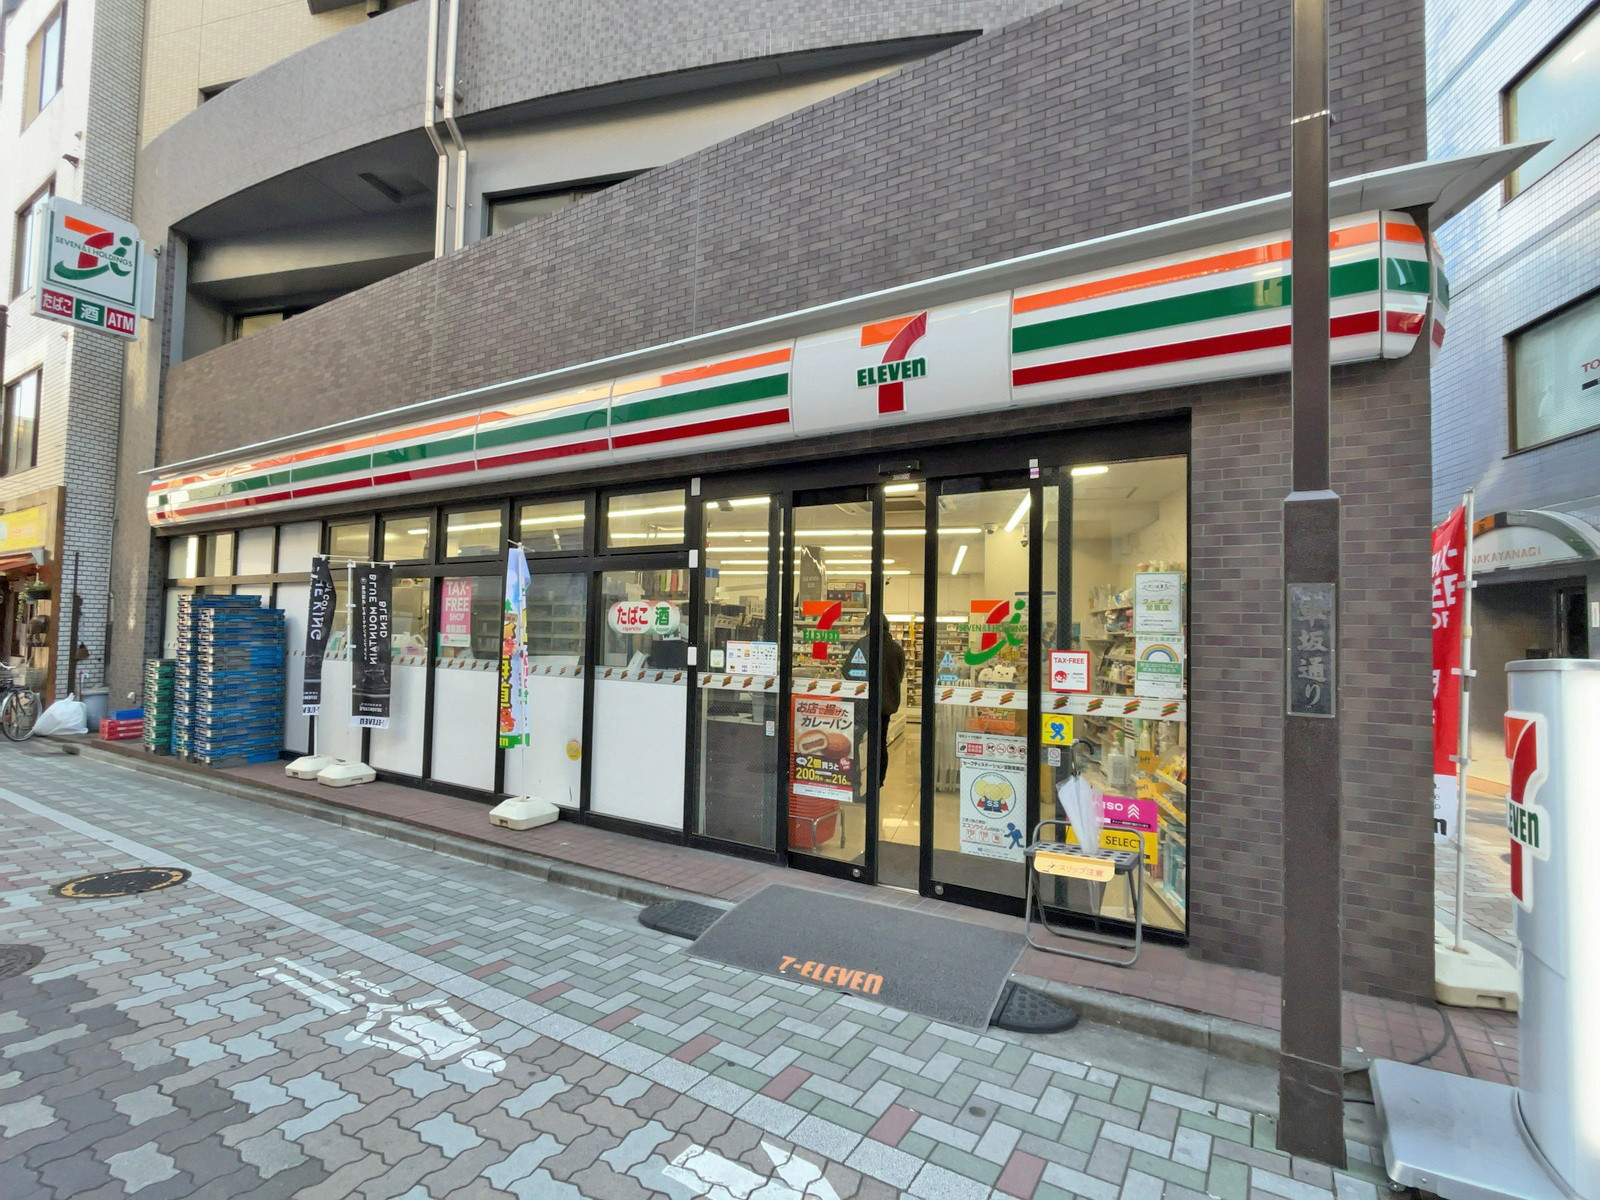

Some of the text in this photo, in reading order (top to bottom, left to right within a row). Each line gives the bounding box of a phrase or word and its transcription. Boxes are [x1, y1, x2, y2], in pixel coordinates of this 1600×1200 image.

[93, 249, 133, 267] HOLDINGS
[42, 292, 72, 315] たばこ
[80, 303, 100, 321] 酒
[107, 311, 134, 332] ATM
[445, 597, 469, 612] FREE
[449, 613, 465, 621] SHOP
[617, 606, 649, 625] たばこ
[655, 606, 670, 625] 酒
[993, 624, 1028, 633] HOLDING
[801, 716, 853, 730] カレーパン
[1103, 801, 1124, 811] ISO
[1508, 802, 1540, 849] EVEn
[1057, 864, 1104, 877] スリップ注意
